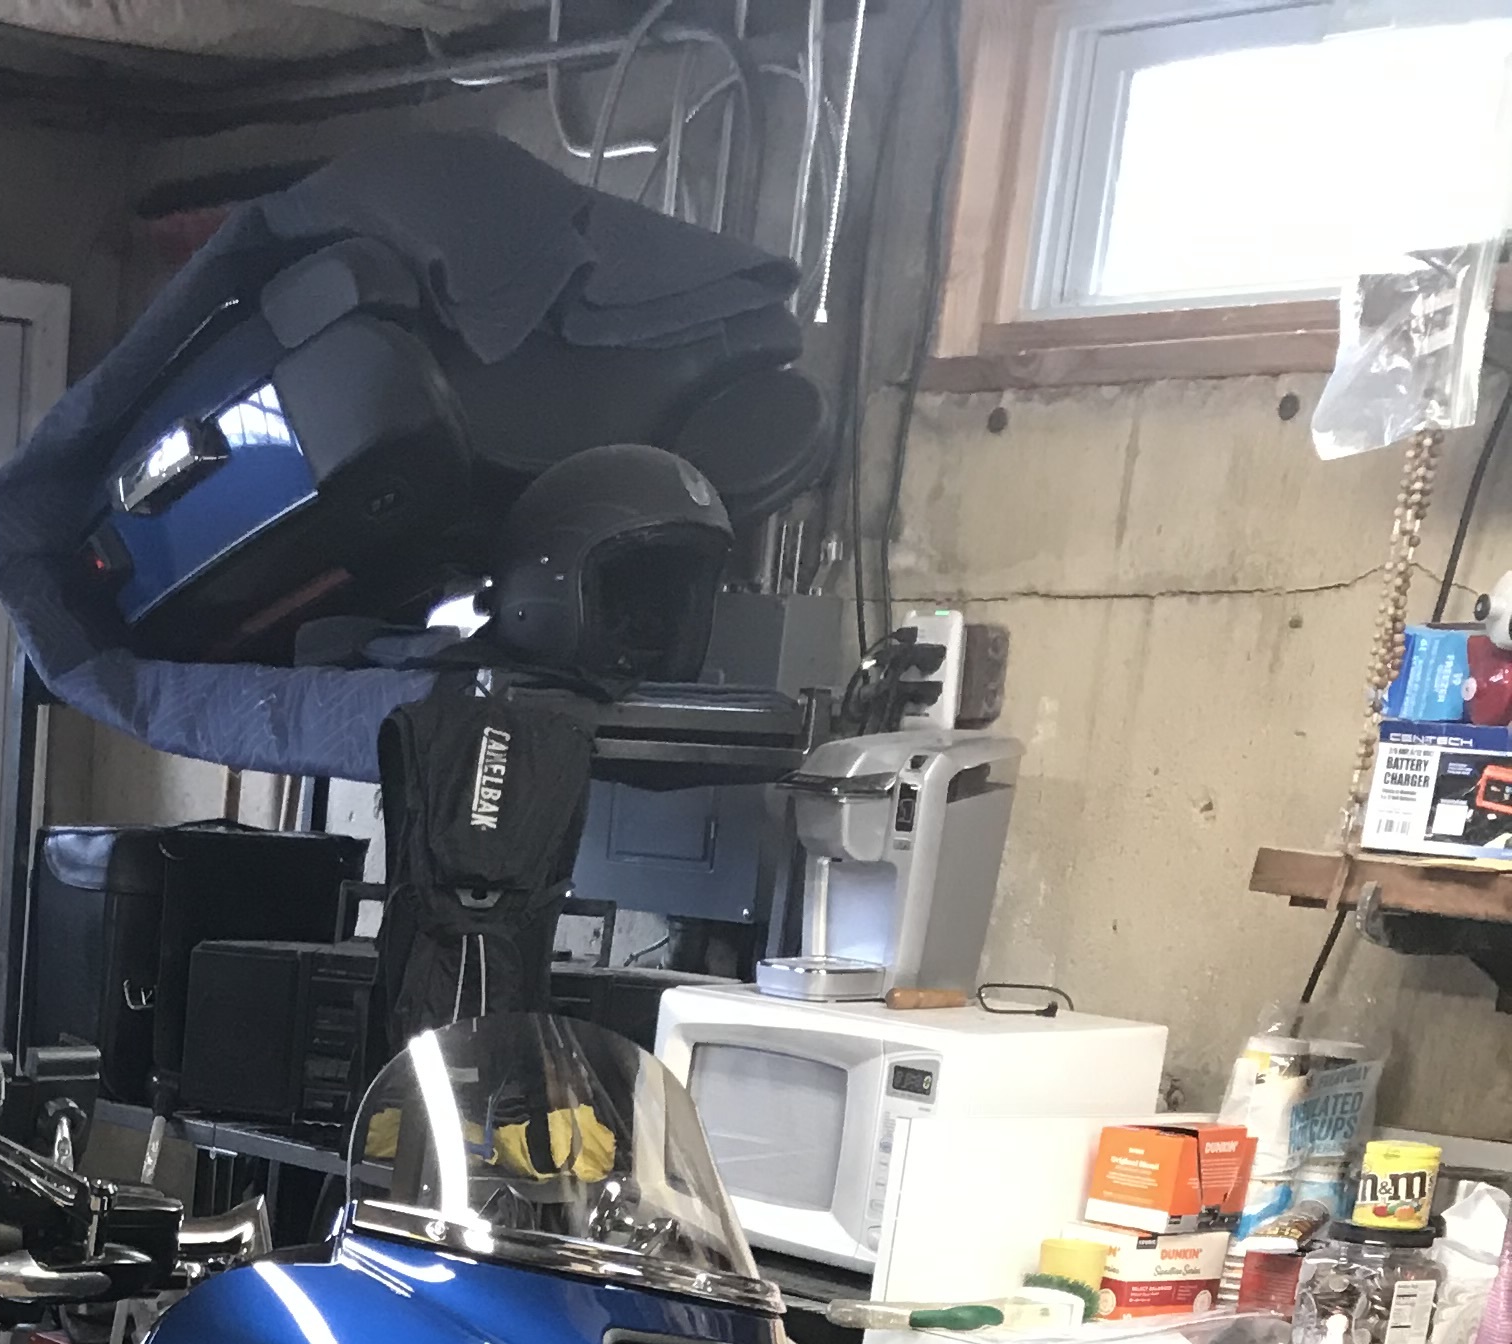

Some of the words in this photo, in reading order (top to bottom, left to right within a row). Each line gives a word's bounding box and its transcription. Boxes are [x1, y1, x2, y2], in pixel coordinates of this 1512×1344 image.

[1386, 756, 1429, 772] BATTERY
[470, 726, 512, 830] CAMELBAK
[1383, 771, 1430, 788] CHARGER
[1309, 1115, 1358, 1142] CUPS
